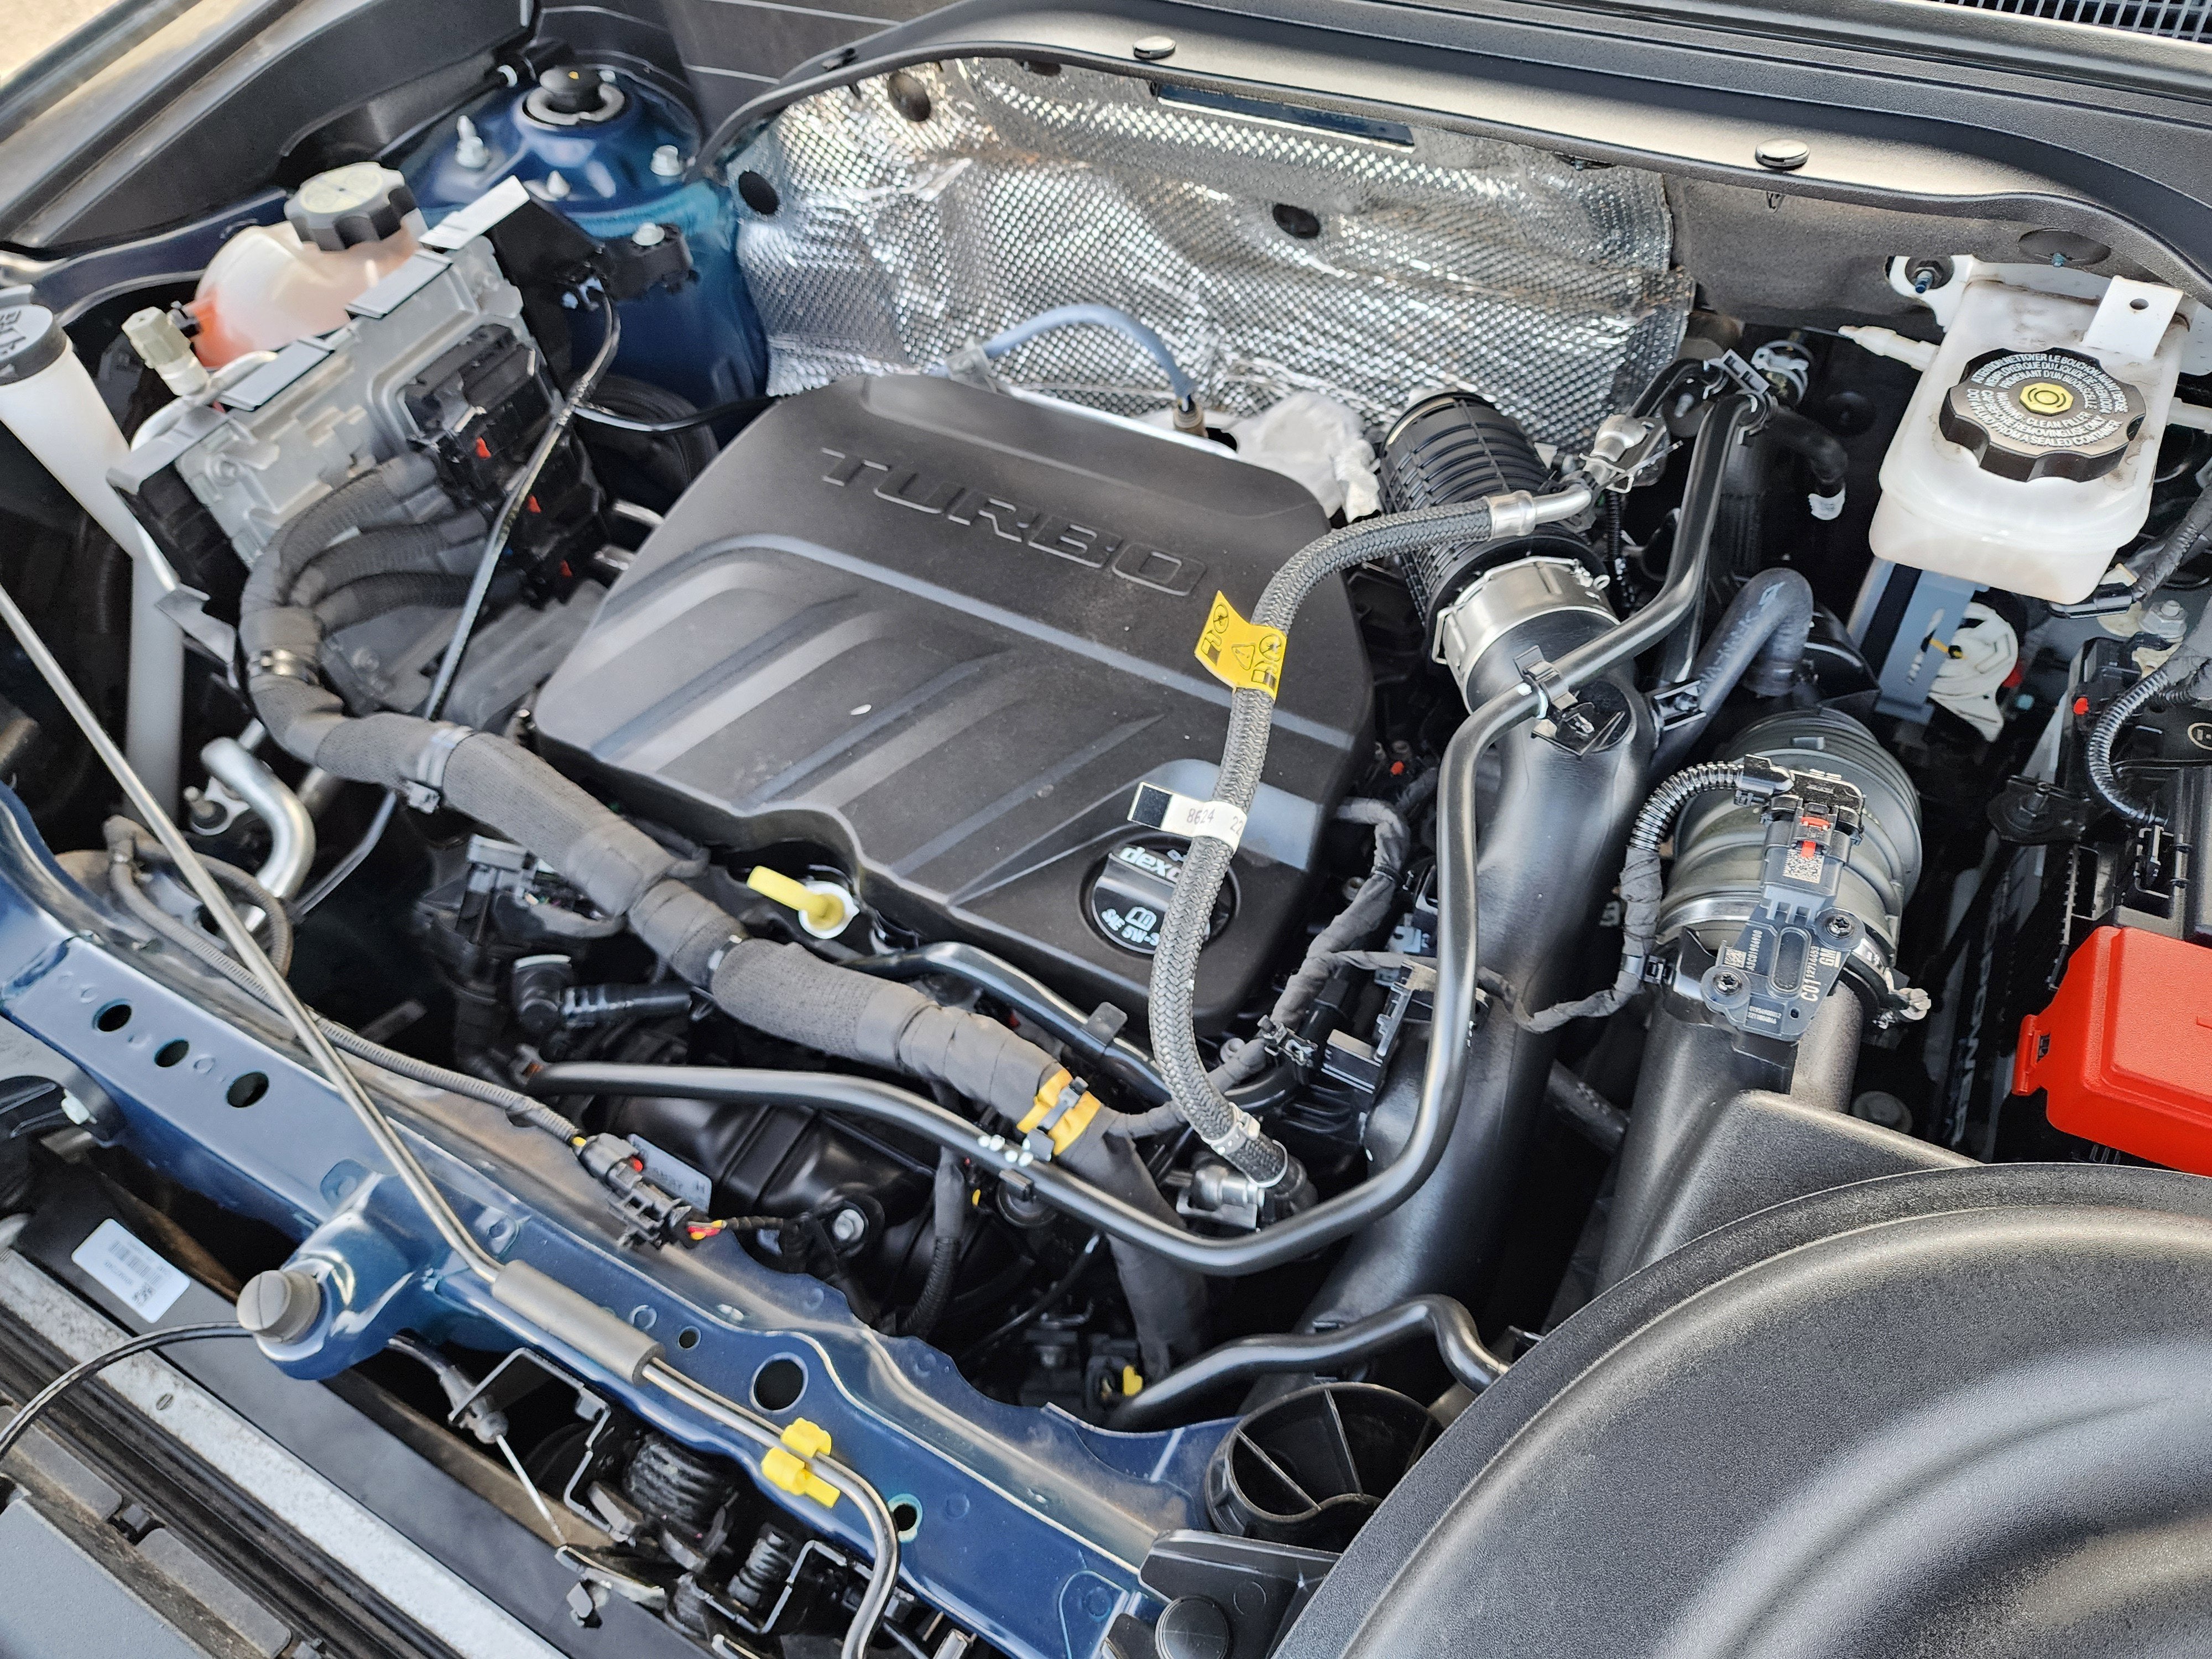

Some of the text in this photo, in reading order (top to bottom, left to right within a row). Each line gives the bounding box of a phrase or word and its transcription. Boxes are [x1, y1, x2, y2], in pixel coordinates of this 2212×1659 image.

[2002, 353, 2047, 365] NETTOYER
[2048, 354, 2061, 363] LE
[2060, 357, 2101, 377] BOUCHON
[2095, 374, 2121, 391] AVANT
[2022, 362, 2042, 370] QUE
[2041, 362, 2054, 370] DU
[2054, 363, 2086, 379] LIQUIDE
[2082, 376, 2098, 385] DE
[2090, 382, 2111, 398] FREIN
[2043, 370, 2063, 380] D'UN
[2062, 375, 2088, 393] BIDON
[1981, 390, 1995, 404] CAP
[1971, 405, 1995, 425] FLUID
[1991, 422, 2021, 440] FROM
[2019, 434, 2029, 443] A
[2030, 436, 2073, 447] SEALED
[1984, 403, 2017, 427] BEFORE
[2026, 417, 2062, 429] CLEAN
[2061, 411, 2093, 428] FILLER
[2085, 415, 2107, 430] ONLY
[821, 447, 1207, 597] TURBO
[1186, 808, 1215, 825] 8624
[1119, 846, 1182, 883] dexo
[1101, 909, 1160, 946] SAE 5W-3
[1818, 947, 1838, 967] GM
